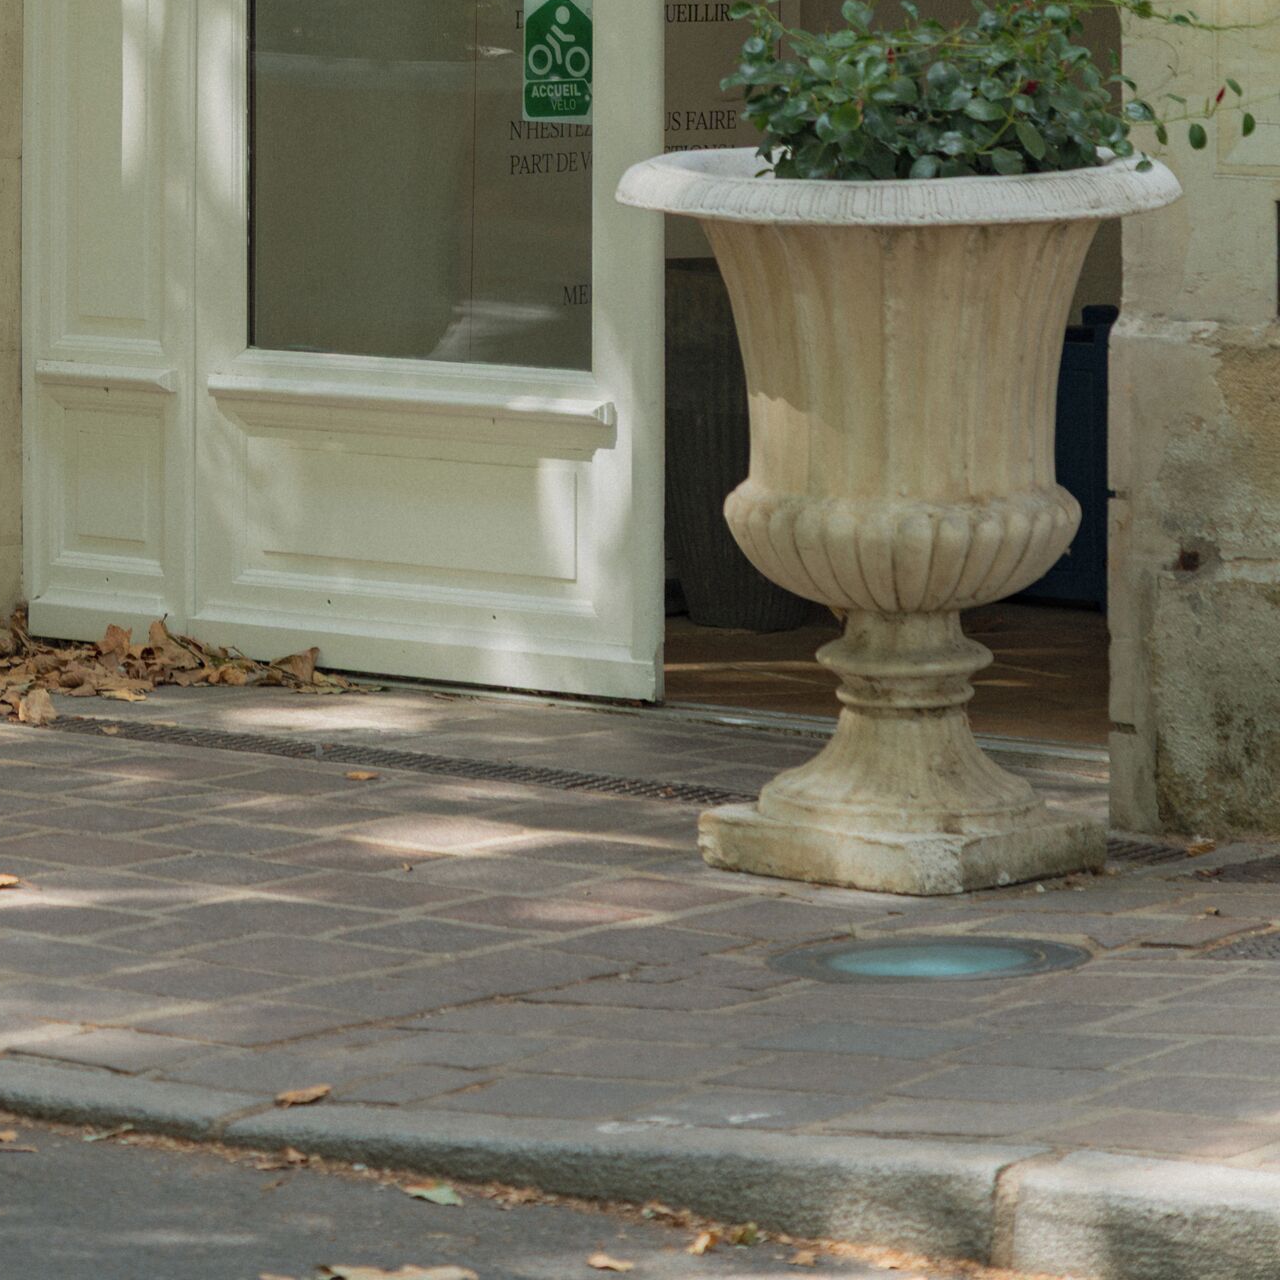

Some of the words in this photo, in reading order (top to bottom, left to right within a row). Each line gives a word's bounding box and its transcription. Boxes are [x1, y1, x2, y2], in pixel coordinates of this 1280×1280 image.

[531, 83, 581, 98] ACCUEIL
[685, 110, 737, 131] FAIRE
[510, 153, 553, 176] PART
[556, 151, 579, 173] DE
